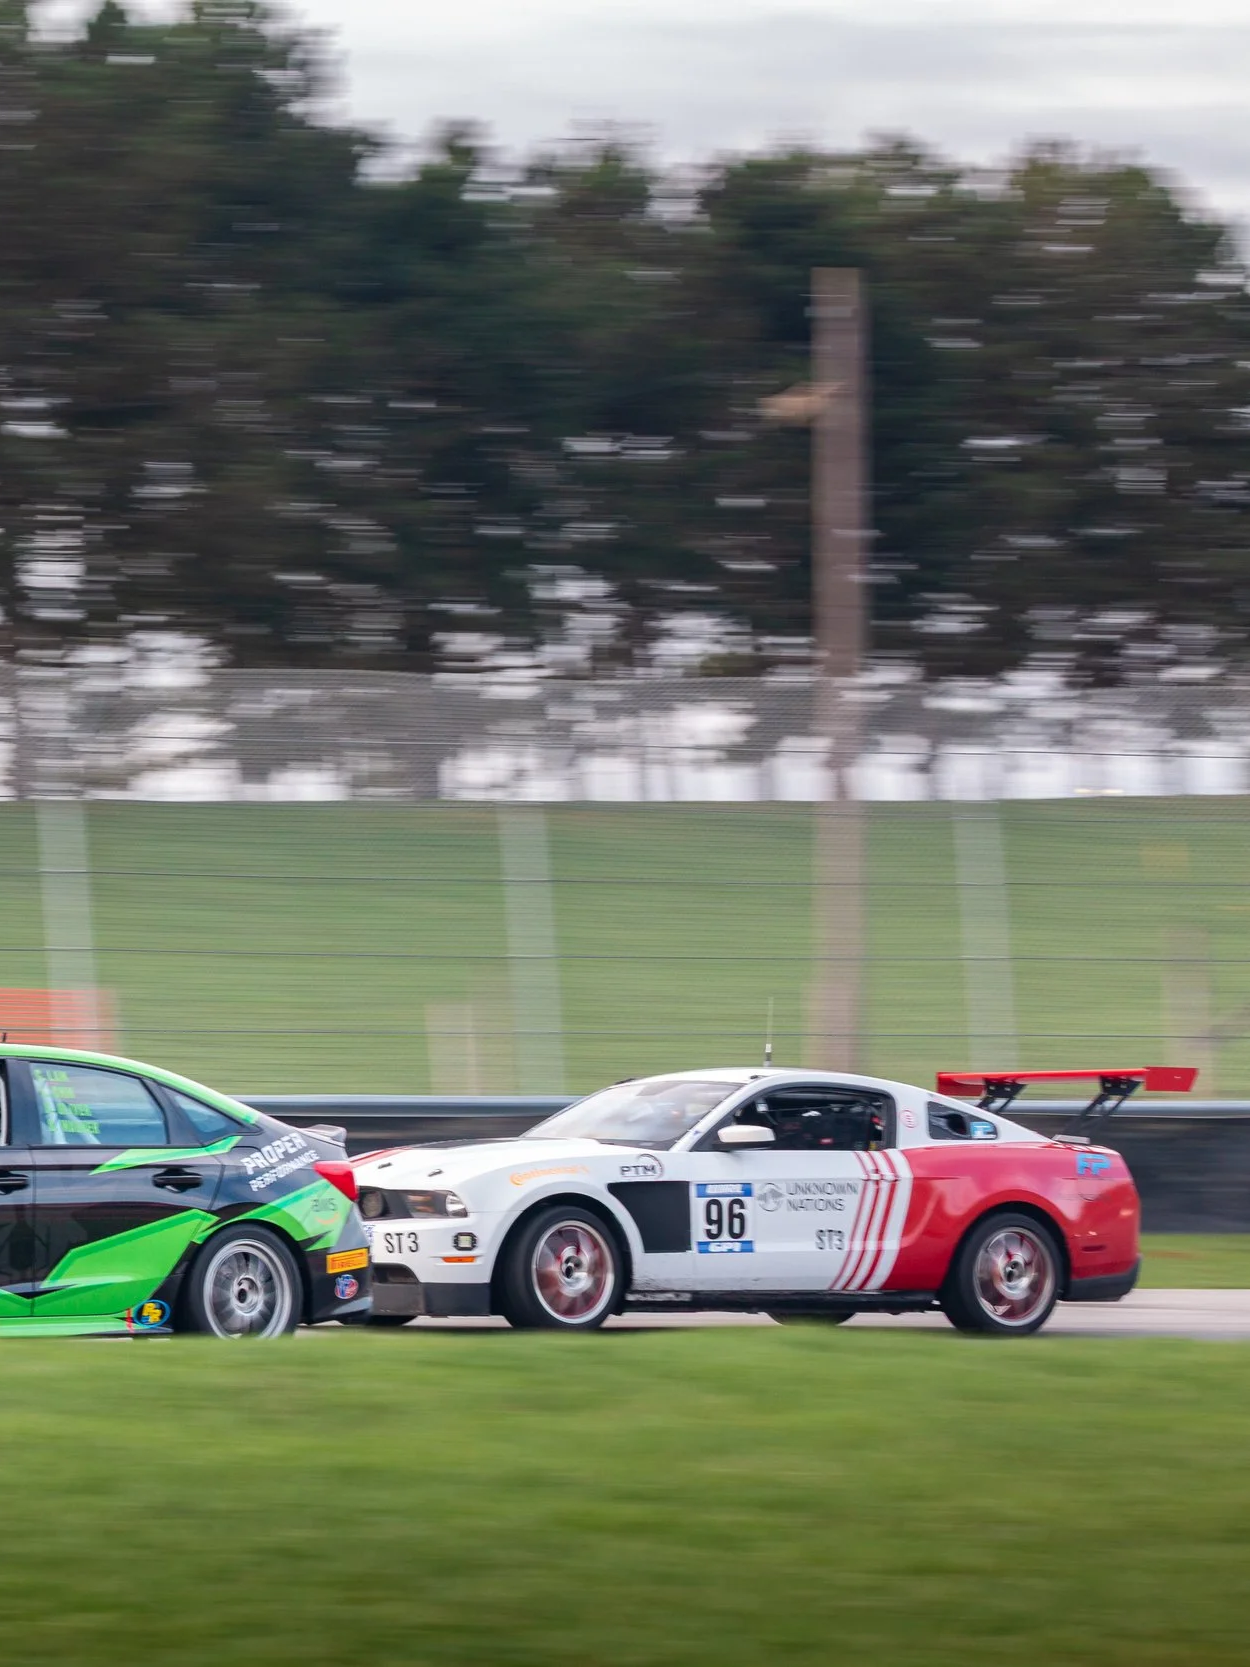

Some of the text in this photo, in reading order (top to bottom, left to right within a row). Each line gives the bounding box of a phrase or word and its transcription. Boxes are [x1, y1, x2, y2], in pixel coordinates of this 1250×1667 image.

[240, 1132, 307, 1175] PROPER
[249, 1150, 320, 1191] PERFORMANCE
[619, 1165, 657, 1176] PTM
[786, 1182, 859, 1196] UNKNOWN
[787, 1198, 846, 1212] NATIONS
[705, 1198, 746, 1240] 96
[815, 1229, 845, 1250] ST3
